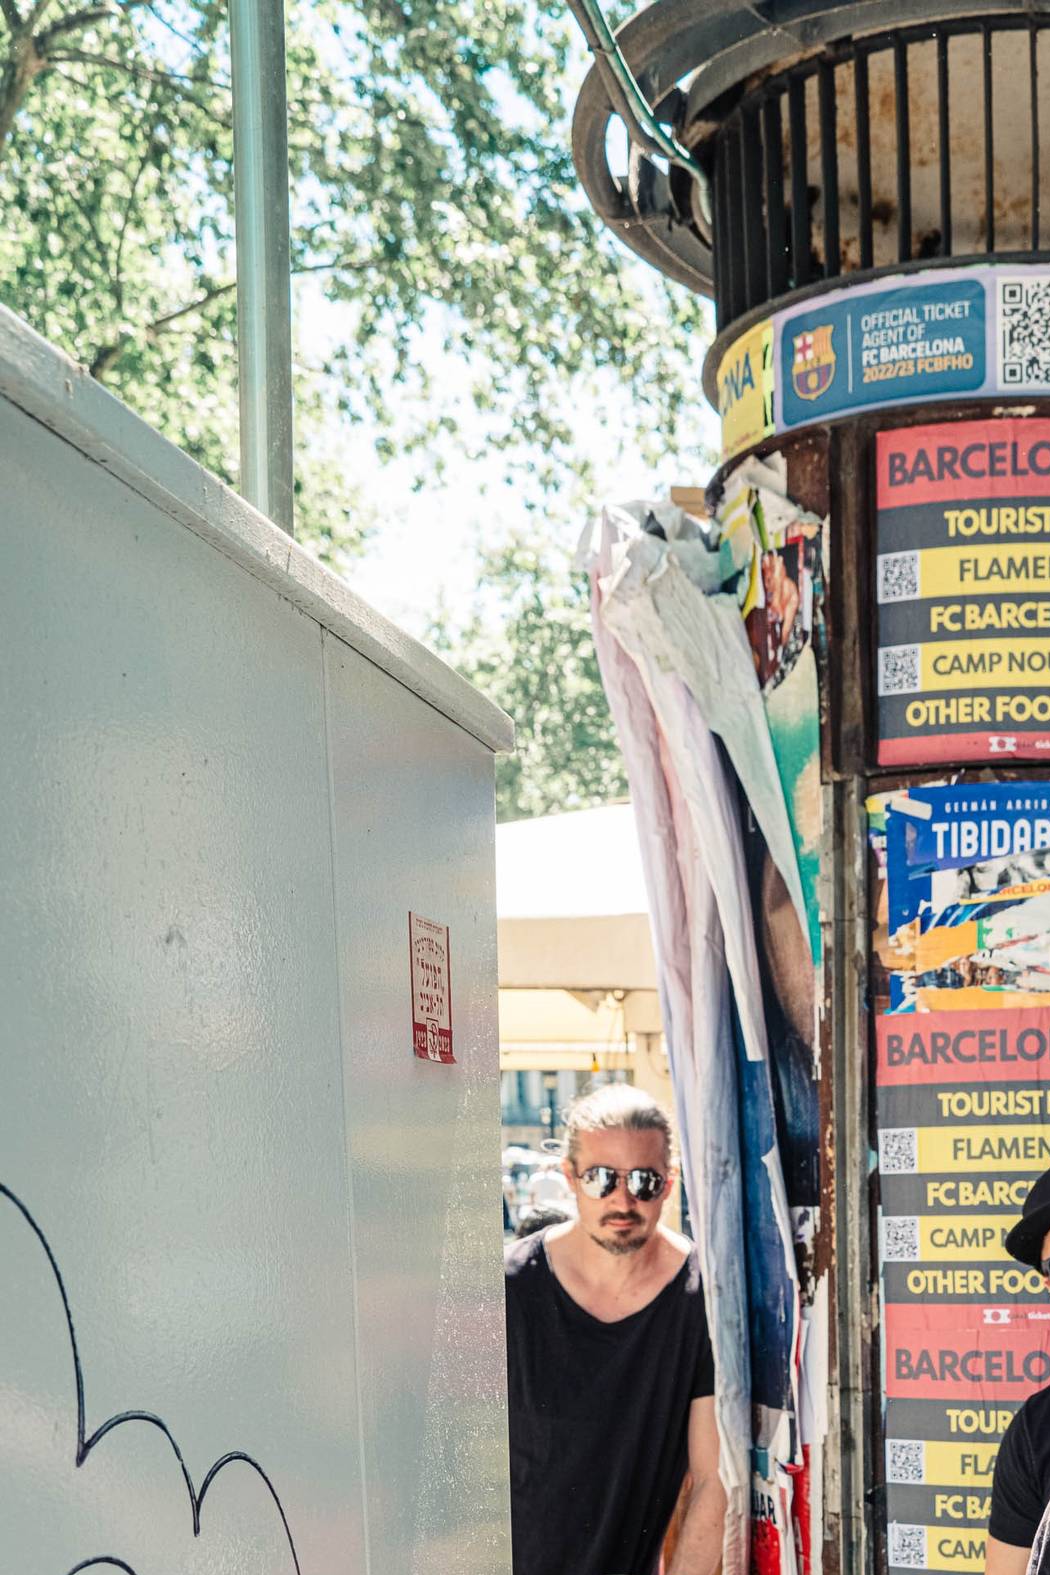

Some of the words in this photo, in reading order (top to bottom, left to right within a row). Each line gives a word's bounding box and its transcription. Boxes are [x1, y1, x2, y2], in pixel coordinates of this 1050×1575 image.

[861, 307, 920, 332] OFFICIAL
[923, 301, 971, 321] TICKET
[862, 327, 906, 348] AGENT
[907, 323, 926, 340] OF
[862, 349, 878, 366] FC
[880, 337, 964, 363] BARCELONA
[863, 360, 915, 383] 2022/23
[930, 605, 963, 632] FC
[933, 652, 1002, 675] CAMP
[906, 697, 991, 727] OTHER
[938, 1091, 1044, 1117] TOURIST
[927, 1184, 957, 1206] FC
[930, 1229, 995, 1247] CAMP
[908, 1270, 986, 1294] OTHER
[946, 1409, 1017, 1433] TOUR
[935, 1495, 964, 1518] FC
